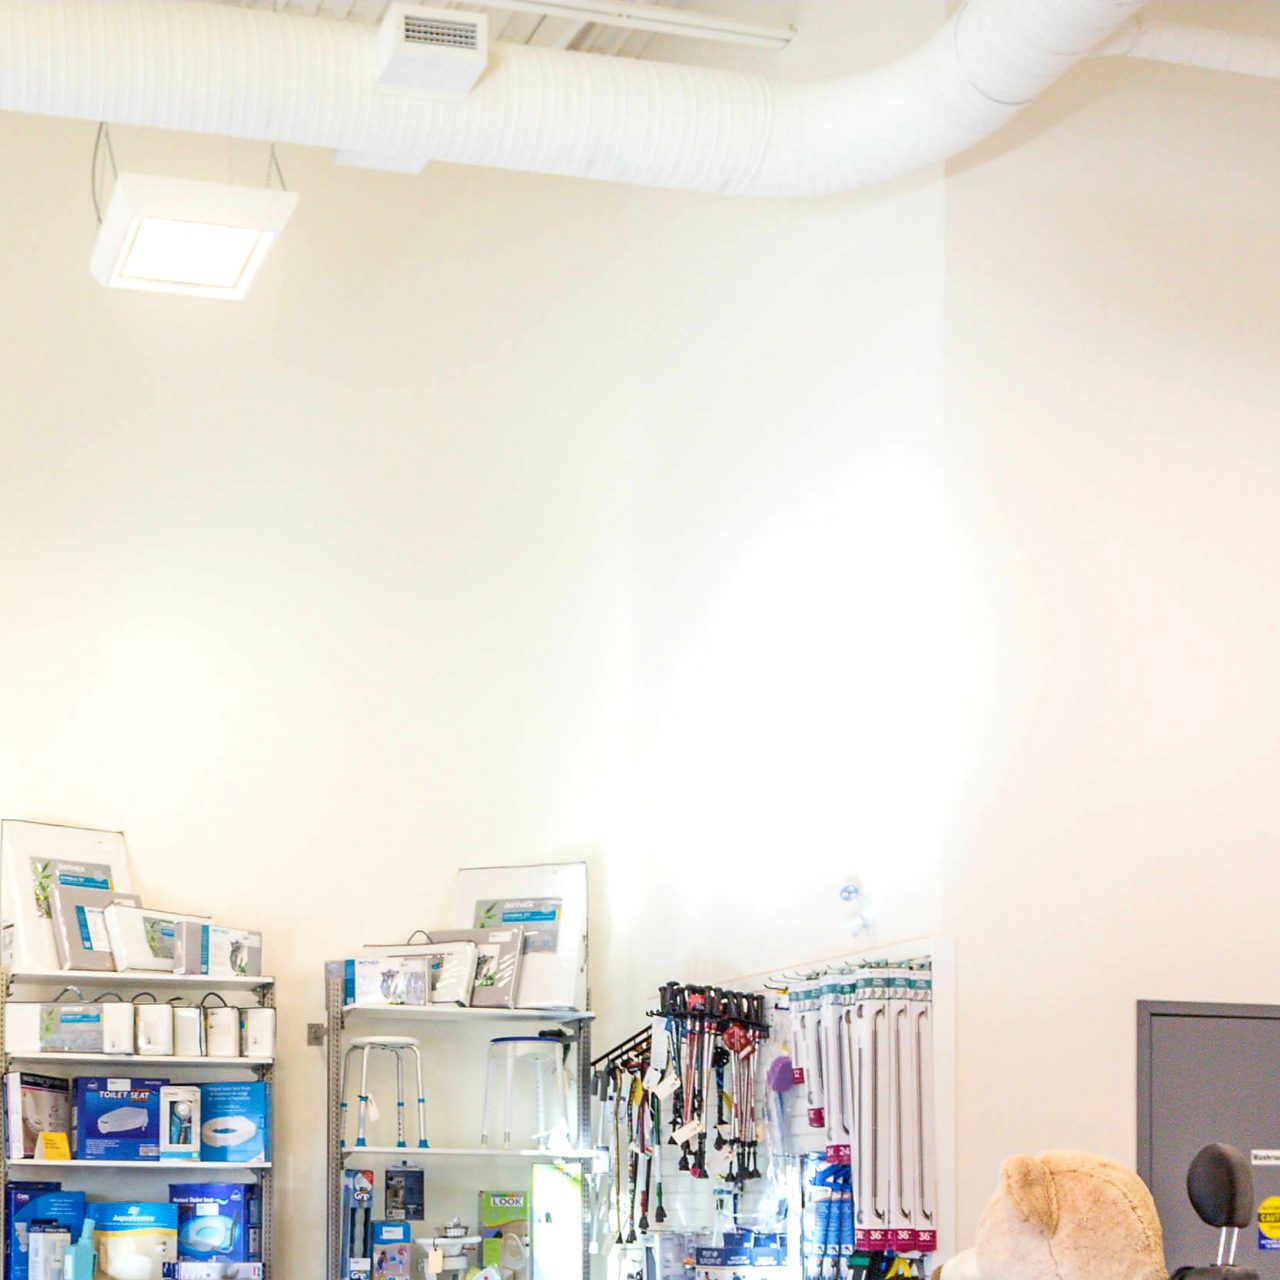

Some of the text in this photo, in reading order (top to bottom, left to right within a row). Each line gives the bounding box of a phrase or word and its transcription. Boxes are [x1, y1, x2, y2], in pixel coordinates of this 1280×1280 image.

[99, 1090, 150, 1099] TOILET SEAT
[492, 1198, 522, 1206] LOOK
